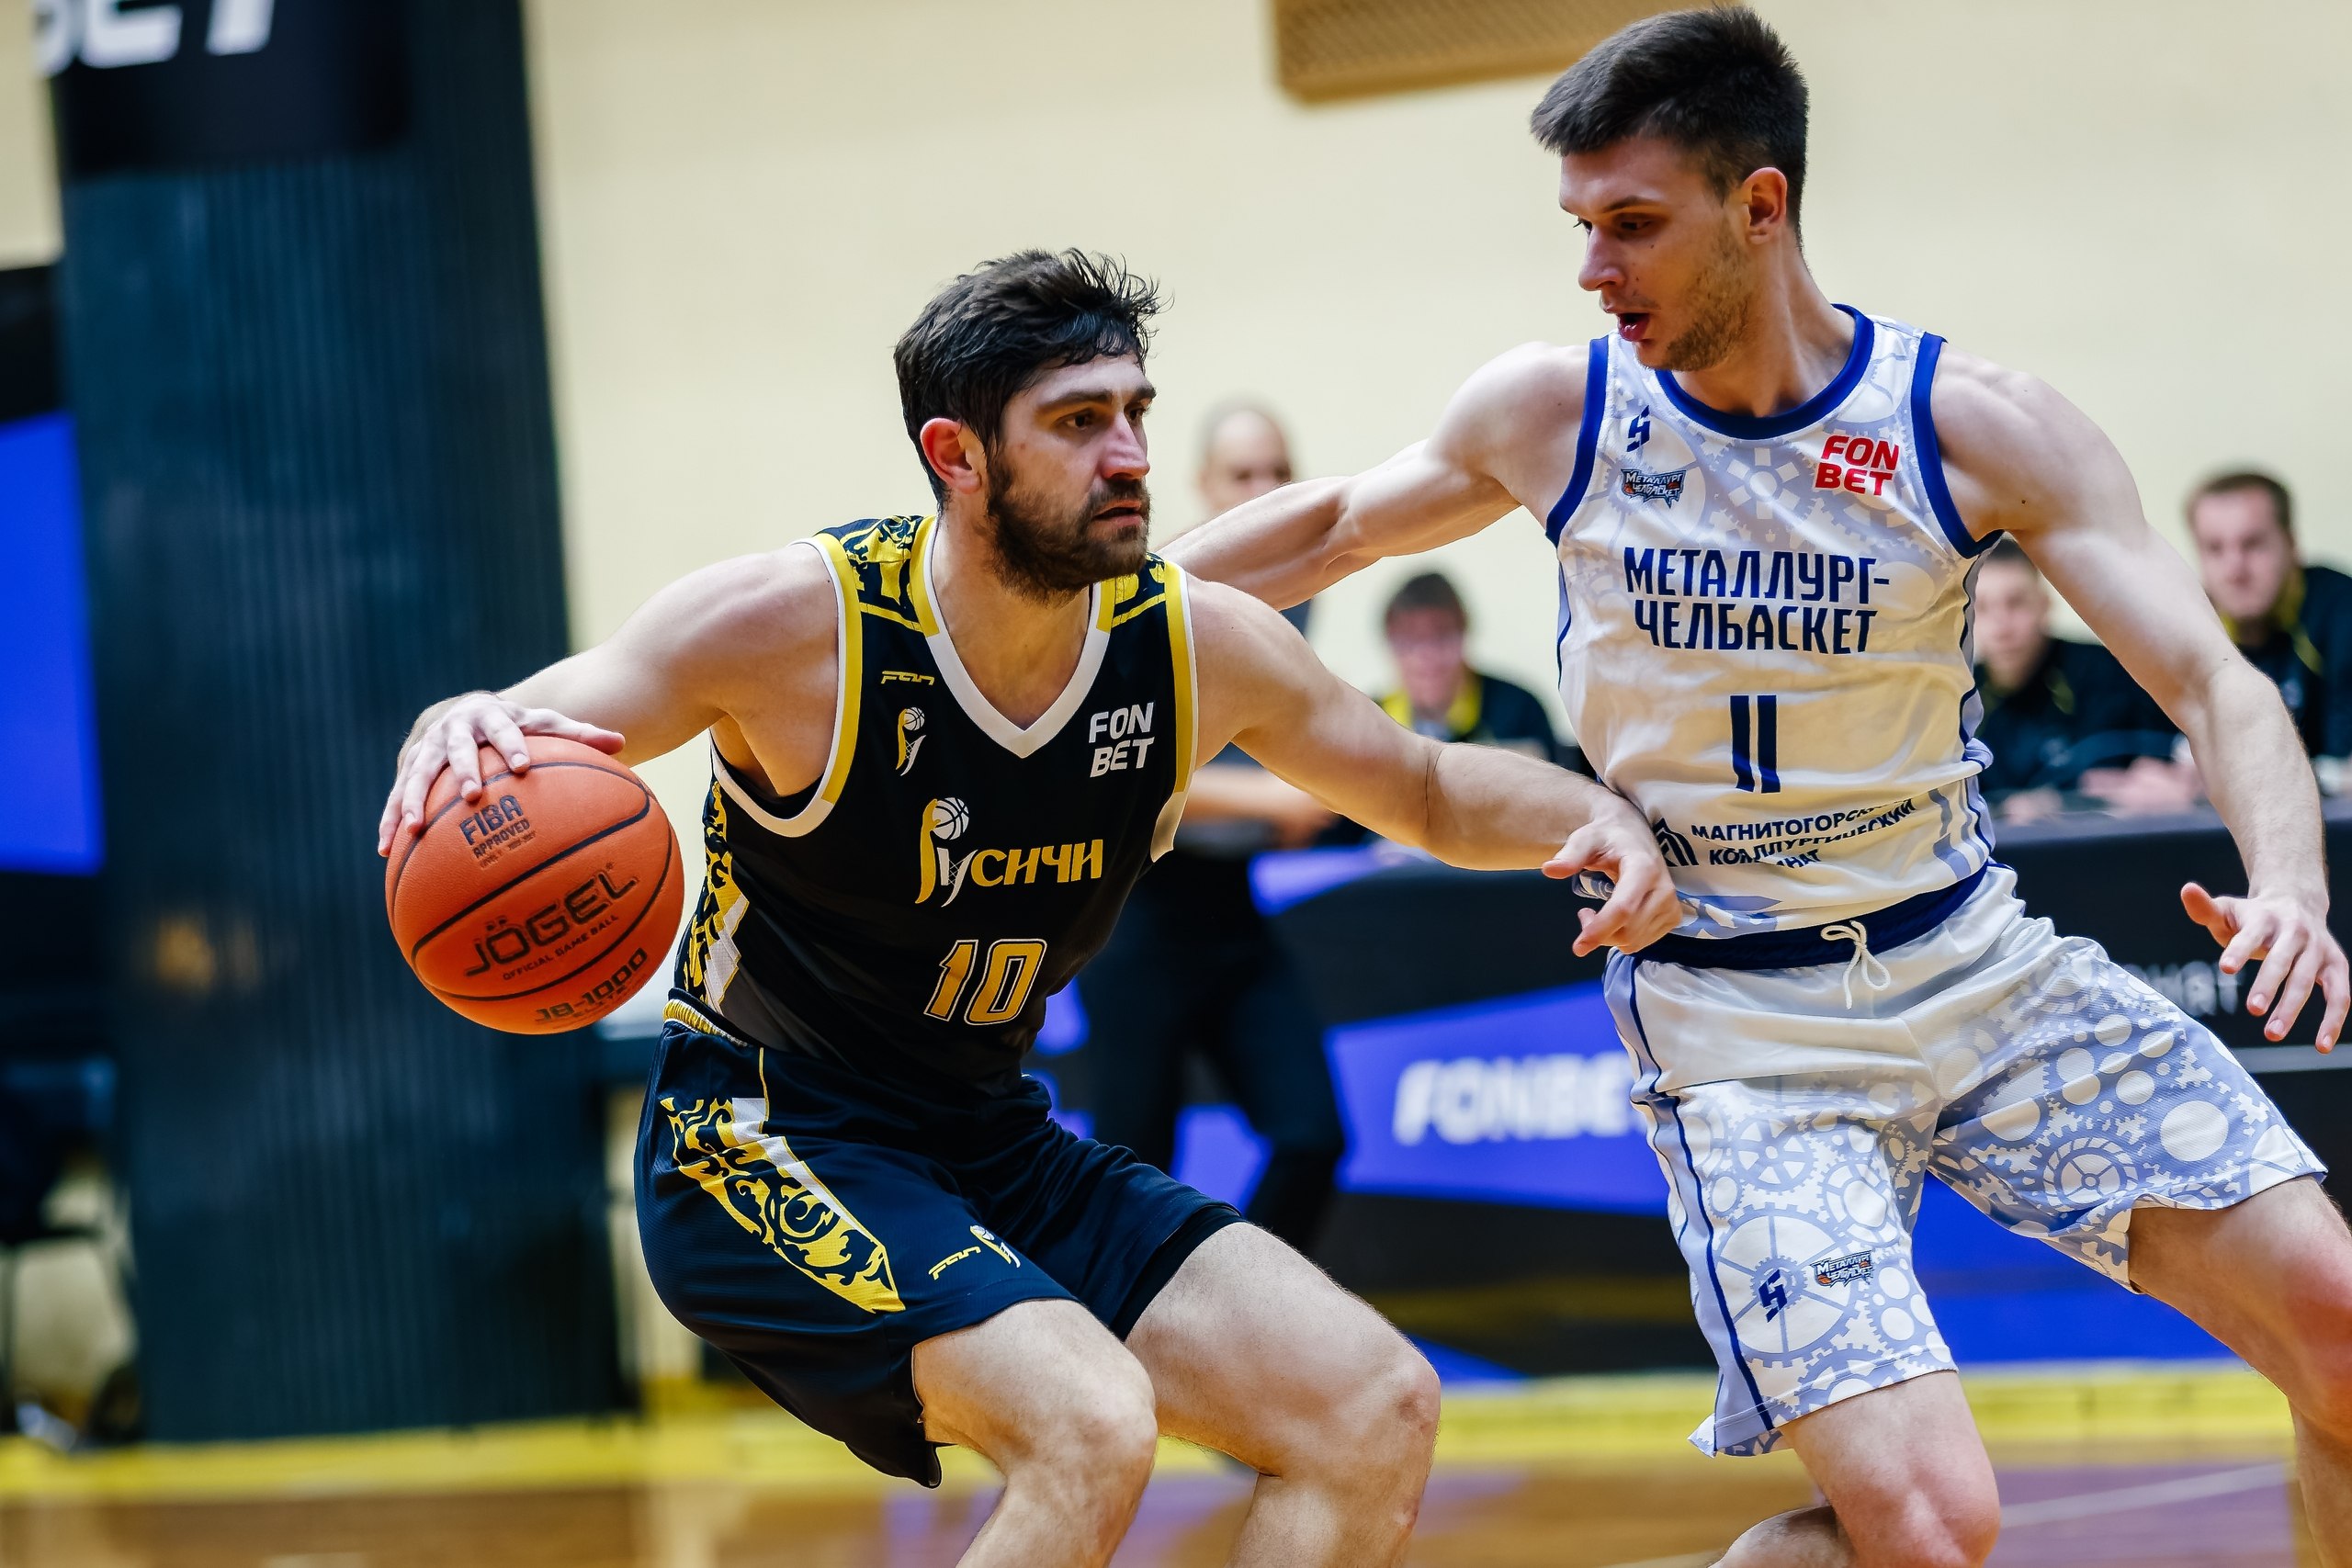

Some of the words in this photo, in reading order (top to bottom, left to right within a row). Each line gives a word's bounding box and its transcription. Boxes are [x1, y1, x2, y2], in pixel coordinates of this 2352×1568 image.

[1815, 462, 1894, 497] BET
[1821, 435, 1899, 471] FON
[1623, 547, 1890, 604] МЕТАЛЛУРГ-
[1634, 599, 1877, 655] ЧЕЛБАСКЕТ
[1089, 701, 1154, 743] FON
[1730, 695, 1781, 794] 11
[1090, 737, 1155, 778] BET
[460, 795, 524, 846] FIBA
[472, 818, 530, 858] APPROVED
[465, 870, 641, 977] JÖGEL
[502, 954, 554, 981] OFFICIAL
[554, 931, 590, 957] GAME
[589, 913, 620, 936] BALL
[923, 938, 1047, 1026] 10
[1392, 1049, 1646, 1145] FONBE
